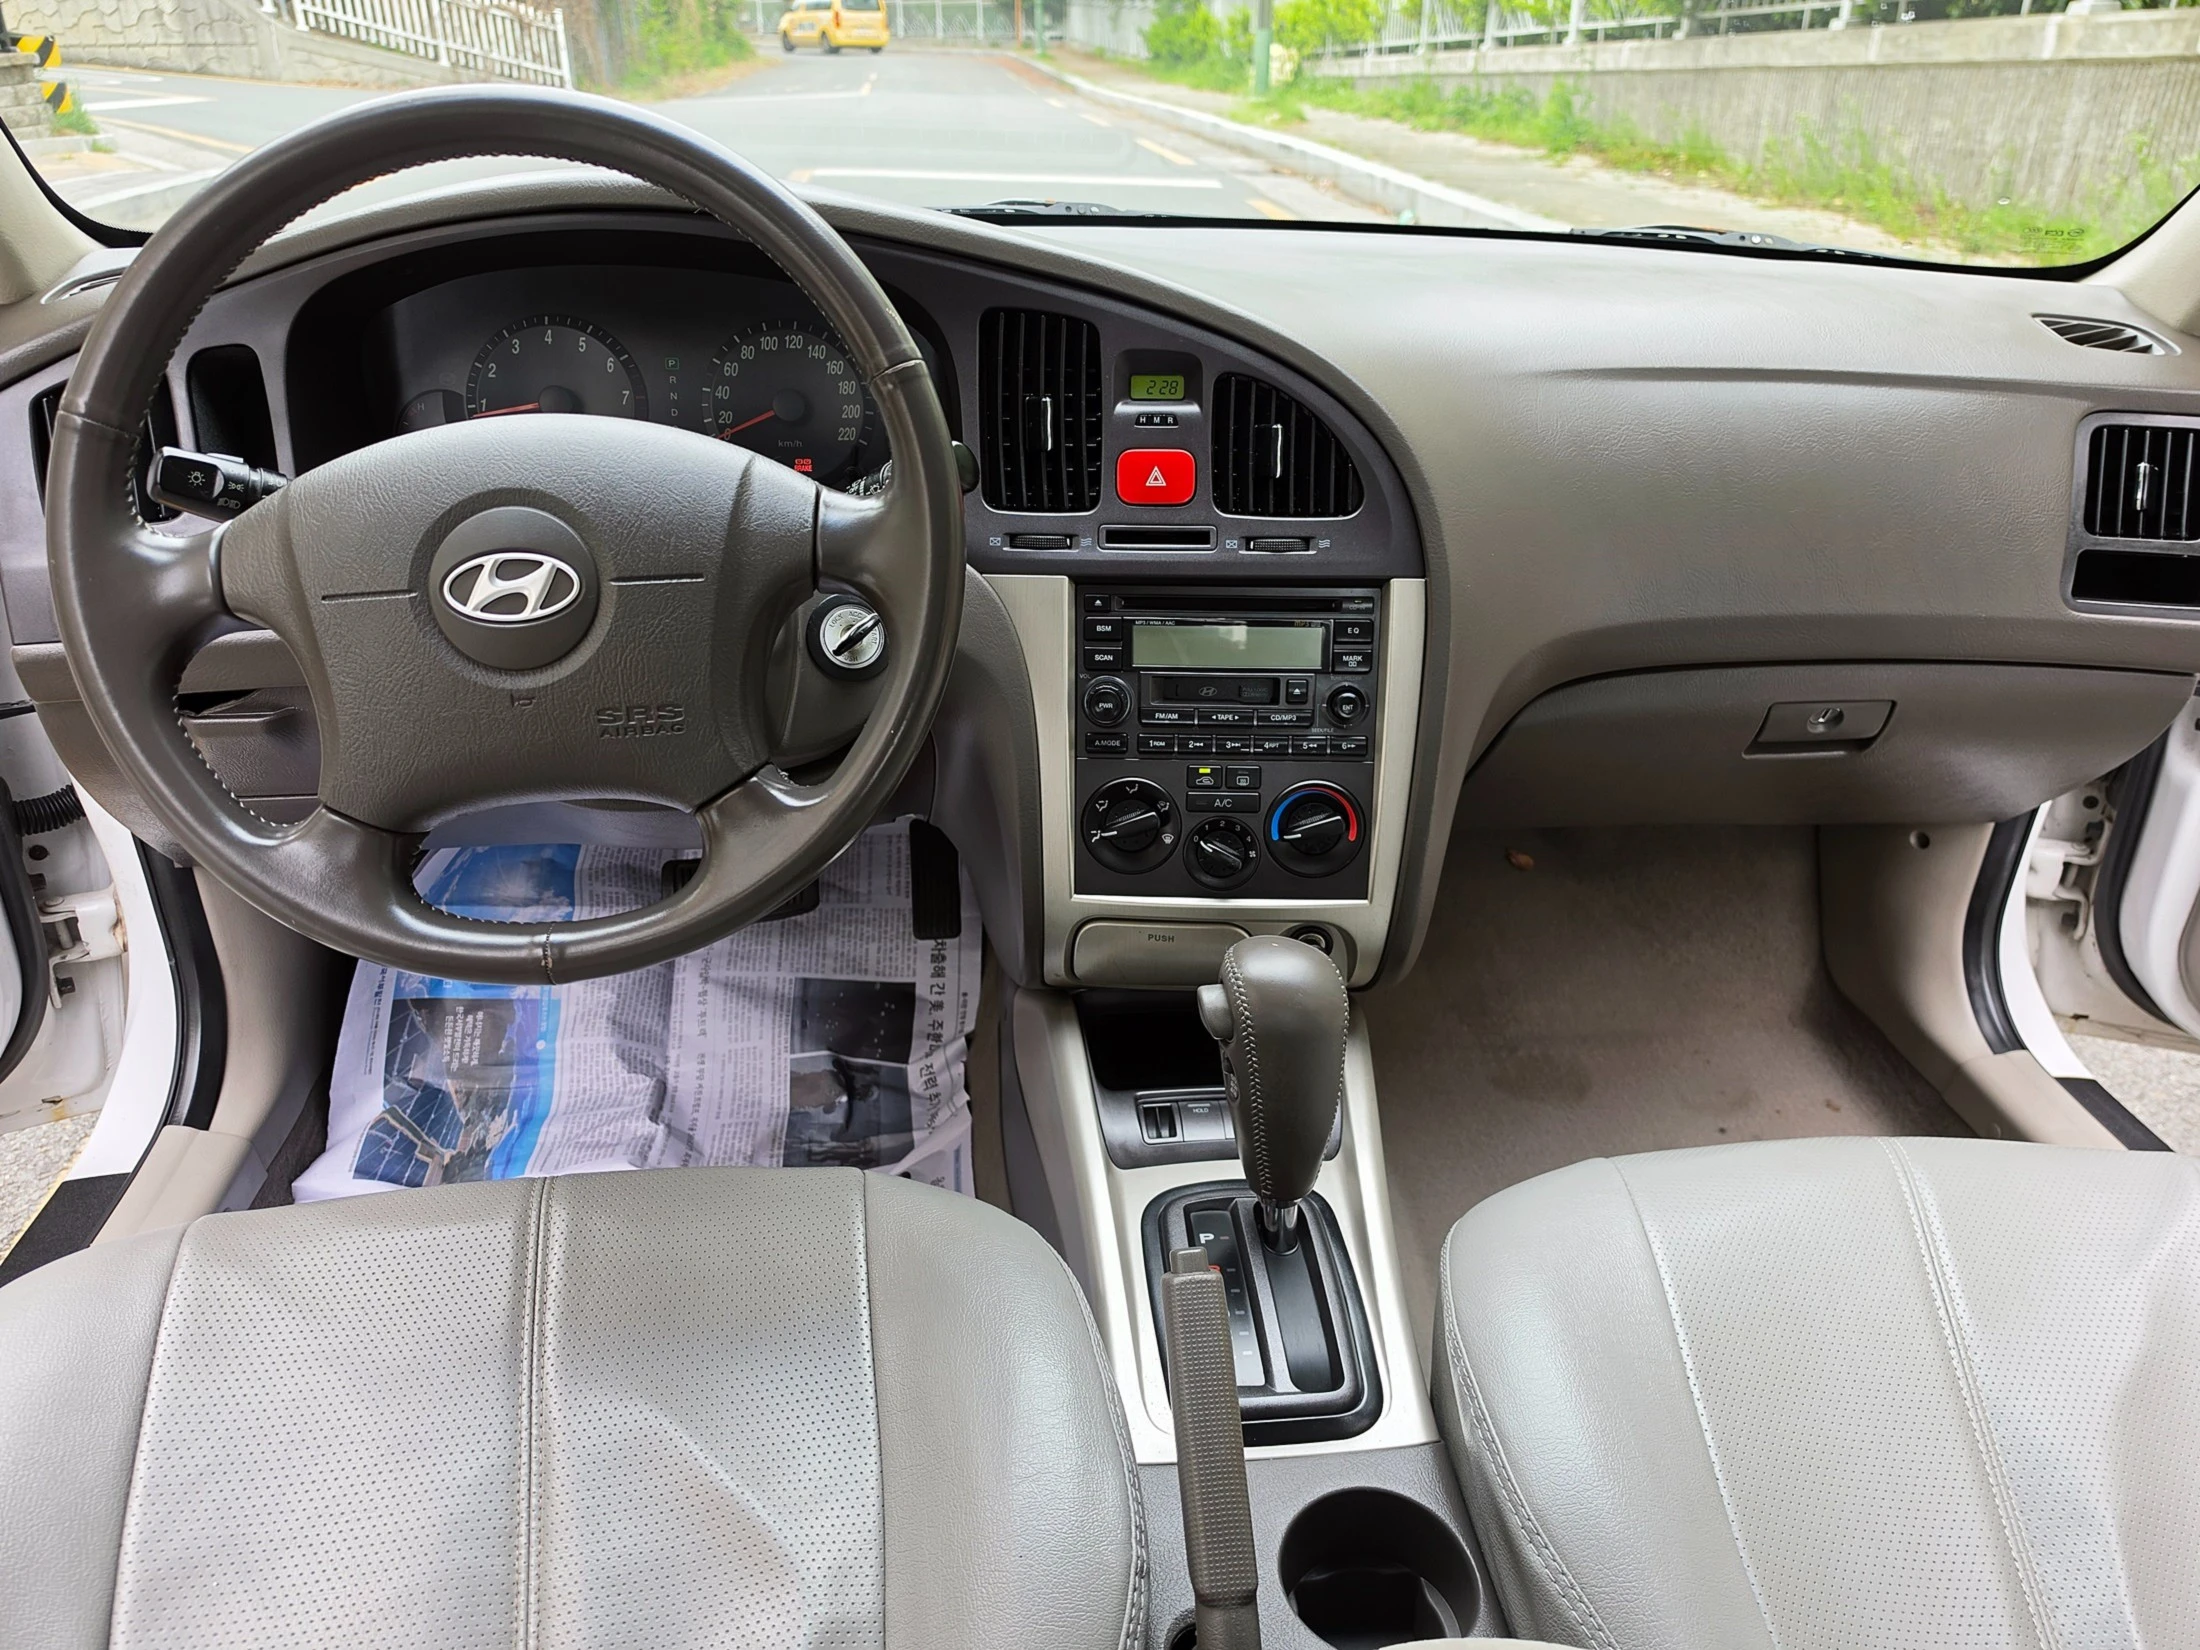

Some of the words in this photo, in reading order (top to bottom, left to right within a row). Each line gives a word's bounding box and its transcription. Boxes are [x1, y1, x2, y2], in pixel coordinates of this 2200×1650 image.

[544, 329, 553, 345] 4
[578, 336, 586, 352] 5
[760, 336, 779, 351] 100
[784, 335, 804, 349] 120
[511, 338, 520, 354] 3
[740, 345, 755, 360] 80
[807, 344, 826, 360] 140
[487, 362, 497, 378] 2
[606, 357, 615, 373] 6
[723, 361, 739, 377] 60
[826, 360, 844, 375] 160
[669, 376, 677, 384] R
[838, 380, 856, 395] 180
[621, 390, 630, 405] 7
[670, 392, 678, 400] N
[715, 385, 730, 400] 40
[480, 398, 487, 412] 1
[671, 408, 679, 417] D
[841, 404, 860, 419] 200
[718, 410, 733, 424] 20
[1139, 416, 1146, 424] H
[1153, 416, 1160, 424] M
[1167, 416, 1174, 424] R
[837, 427, 857, 441] 220
[778, 439, 804, 448] km/h
[1096, 625, 1112, 633] BSM
[1094, 654, 1113, 662] SCAN
[596, 705, 686, 726] SRS
[600, 723, 687, 740] AIRBAG
[1214, 798, 1233, 808] A/C
[1147, 934, 1175, 943] PUSH
[930, 982, 946, 995] 간
[919, 1062, 938, 1092] 전력
[1199, 1233, 1215, 1244] P
